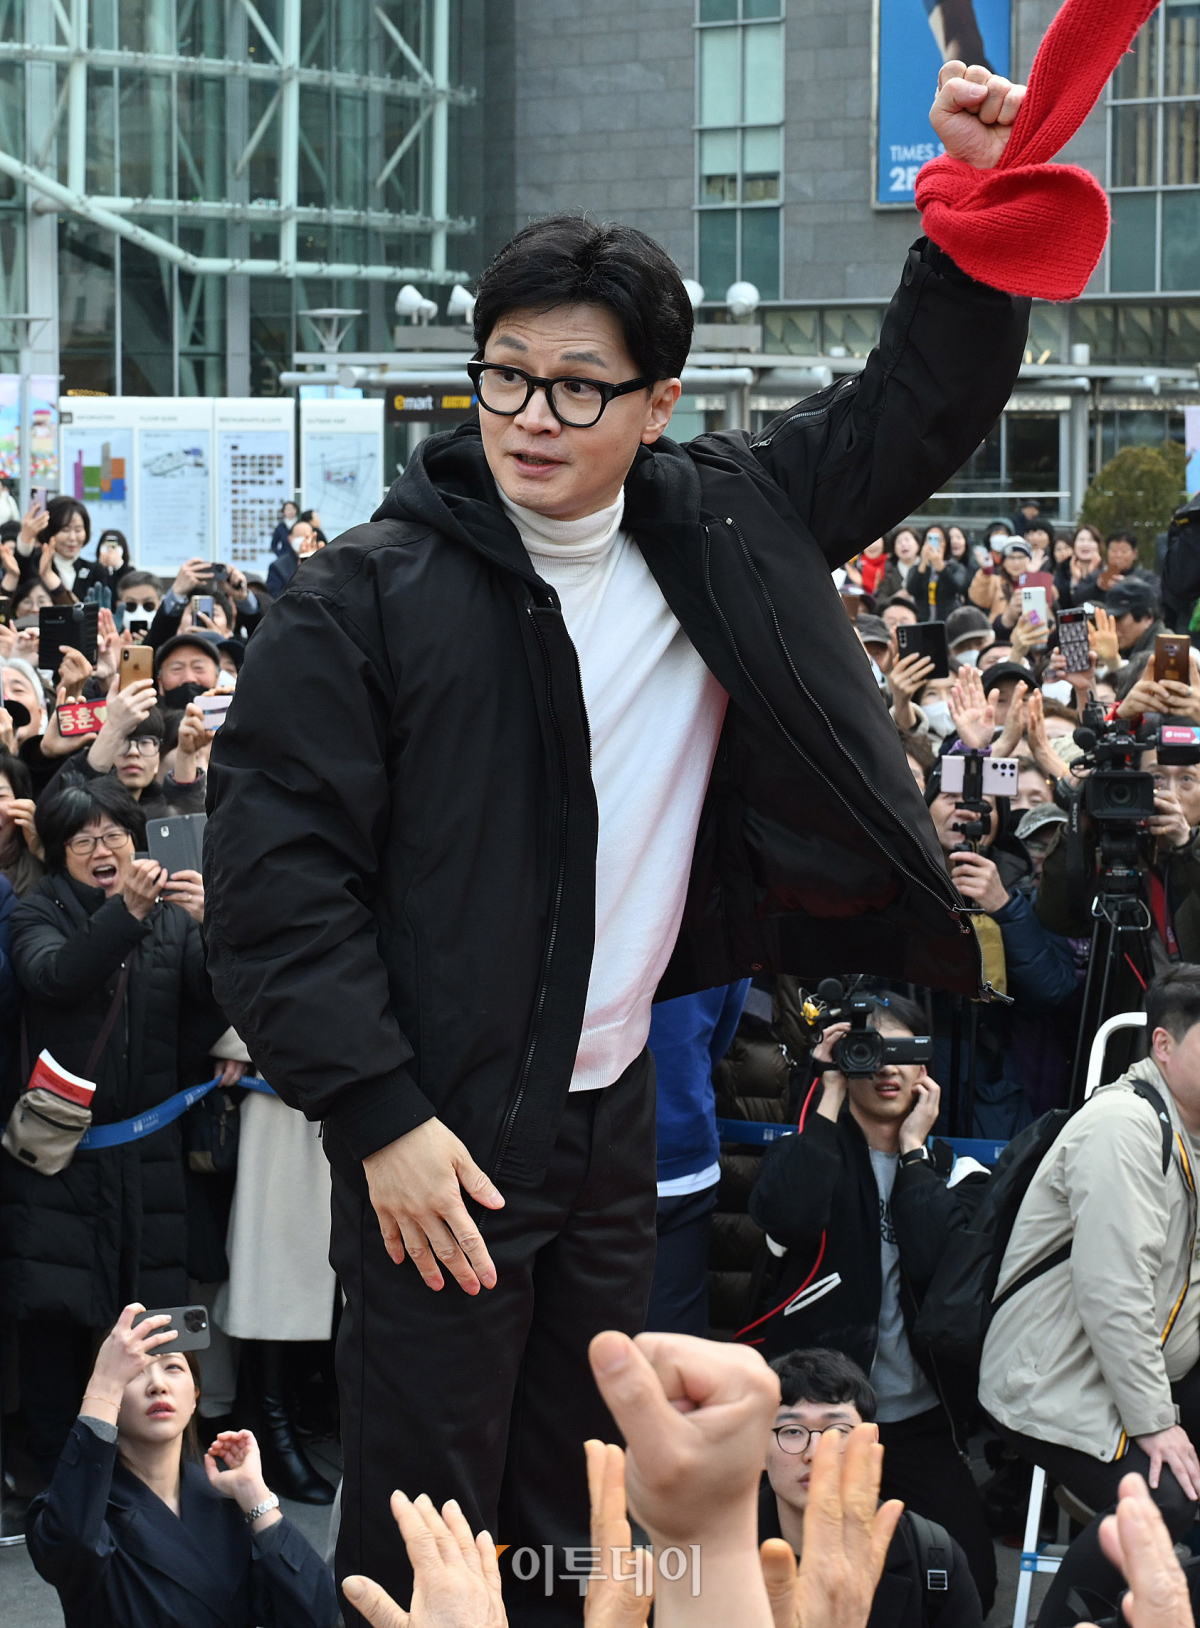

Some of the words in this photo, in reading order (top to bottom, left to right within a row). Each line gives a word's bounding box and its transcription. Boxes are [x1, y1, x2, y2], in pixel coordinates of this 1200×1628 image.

[890, 143, 935, 162] TIMES
[394, 394, 433, 411] emart
[58, 707, 95, 732] 동훈
